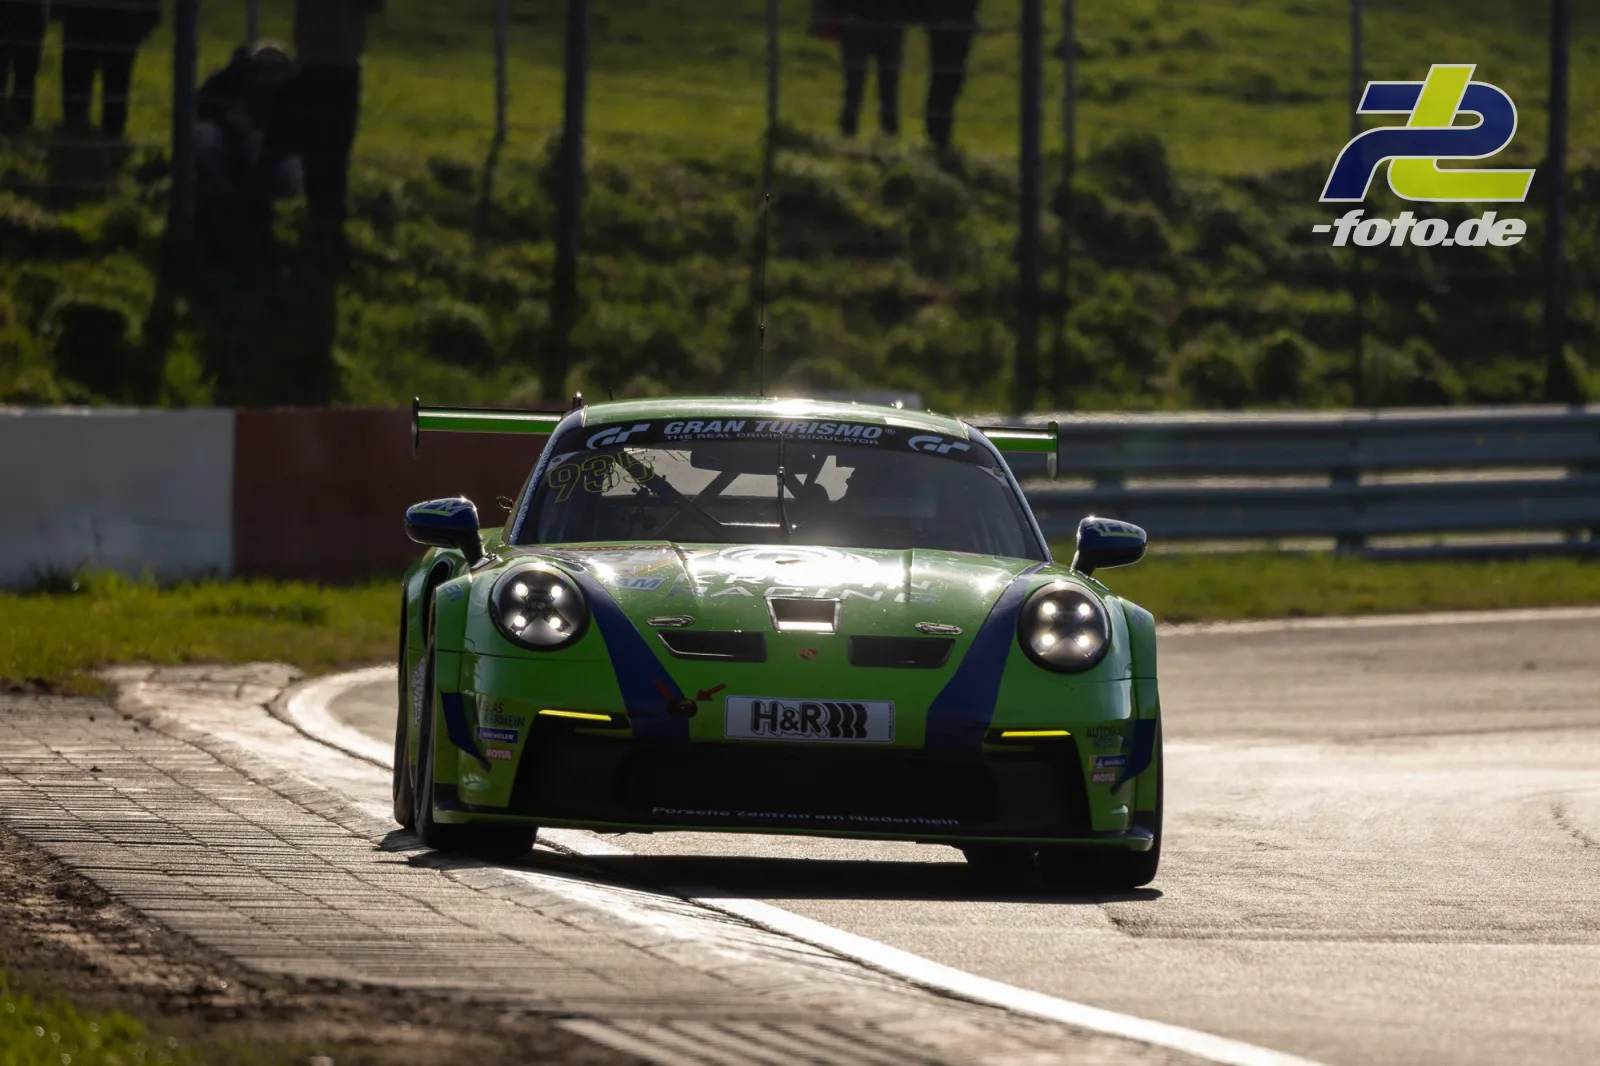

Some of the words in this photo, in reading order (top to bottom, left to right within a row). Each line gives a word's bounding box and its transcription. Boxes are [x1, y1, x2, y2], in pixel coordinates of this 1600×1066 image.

[663, 420, 746, 435] GRAN
[798, 434, 879, 445] SIMULATOR
[548, 452, 656, 504] 935
[751, 700, 829, 738] H&R
[652, 806, 731, 817] Porsche
[736, 810, 811, 819] Zentren
